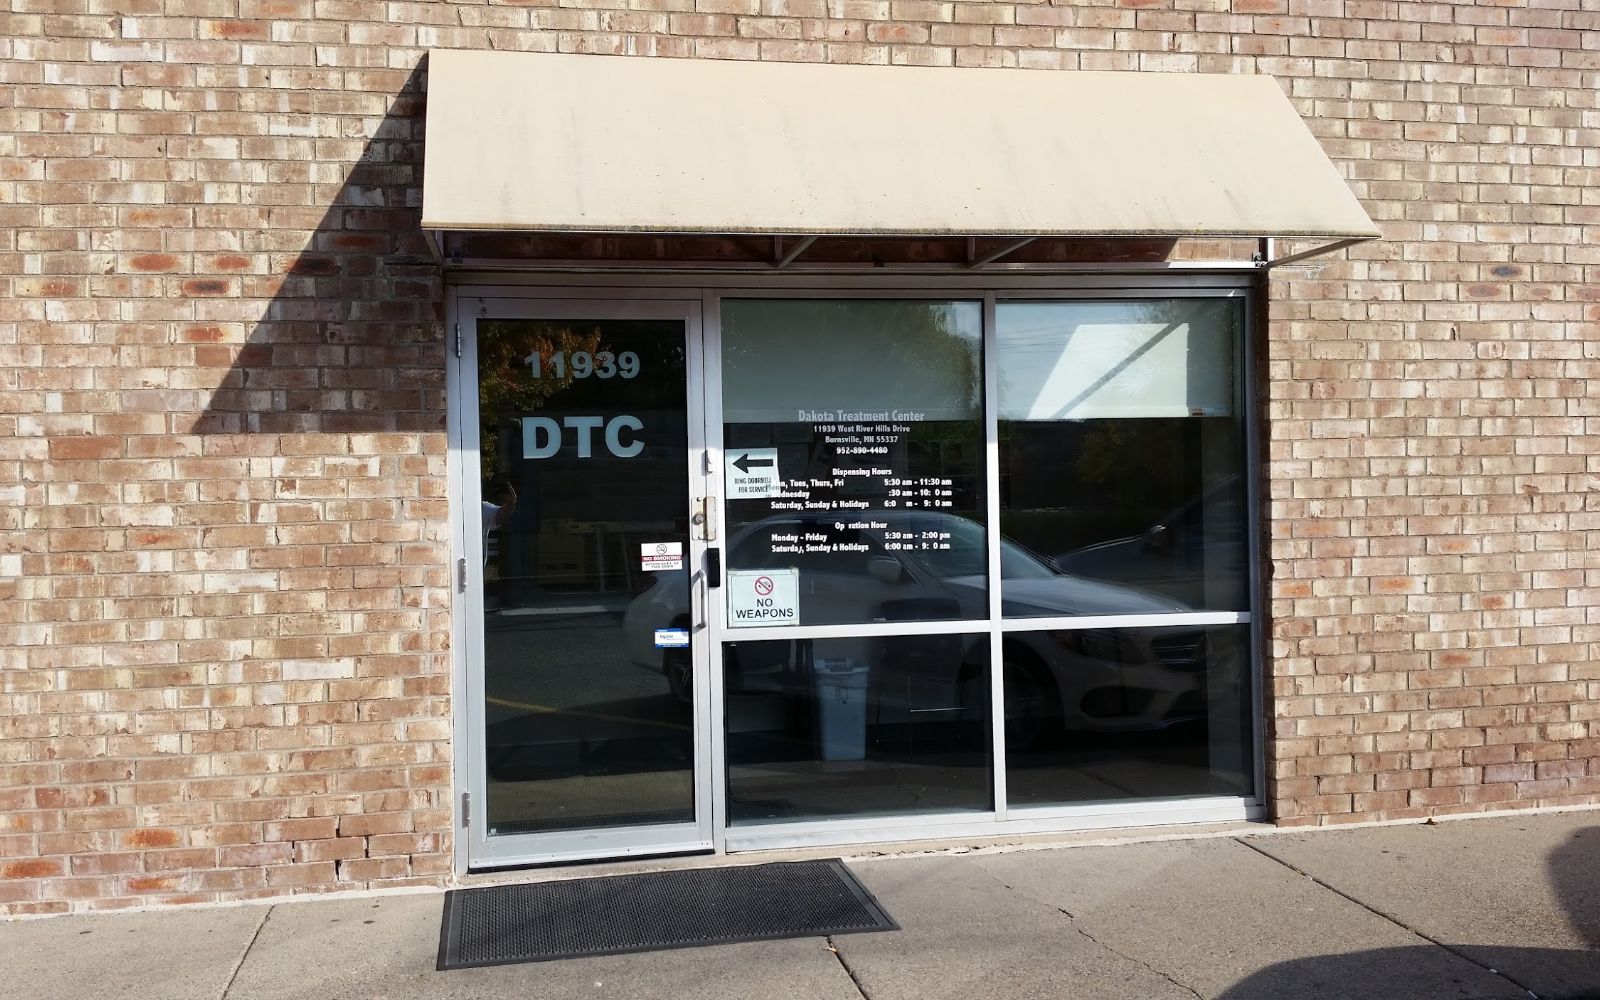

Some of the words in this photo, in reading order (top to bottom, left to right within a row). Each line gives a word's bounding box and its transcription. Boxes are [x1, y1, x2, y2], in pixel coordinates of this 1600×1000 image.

[524, 351, 641, 379] 11939
[799, 410, 834, 422] Dakota
[837, 410, 890, 422] Treatment
[891, 410, 925, 422] Center
[814, 424, 836, 433] 11939
[838, 424, 855, 433] West
[856, 424, 874, 433] River
[876, 424, 891, 433] Hills
[893, 424, 911, 432] Drive
[522, 415, 645, 459] DTC
[826, 435, 862, 445] Burnsville,
[864, 435, 875, 443] MN
[877, 435, 899, 443] 55337
[837, 446, 888, 455] 952-890-4480
[833, 467, 871, 478] Dispensing
[872, 467, 893, 476] Hours
[789, 479, 809, 490] Tues,
[810, 478, 833, 489] Thurs,
[834, 478, 845, 487] Fri
[884, 478, 901, 486] 5:30
[920, 477, 941, 486] 11:30
[771, 500, 804, 511] Saturday,
[805, 500, 831, 511] Sunday
[832, 500, 838, 508] &
[840, 500, 870, 510] Holidays
[772, 533, 799, 544] Monday
[806, 532, 828, 543] Friday
[885, 531, 902, 540] 5:30
[922, 531, 939, 539] 2:00
[940, 532, 951, 541] pm
[806, 543, 832, 554] Sunday
[832, 543, 839, 552] &
[840, 542, 870, 553] Holidays
[885, 542, 902, 551] 6:00
[756, 598, 773, 607] NO
[735, 608, 794, 619] WEAPONS
